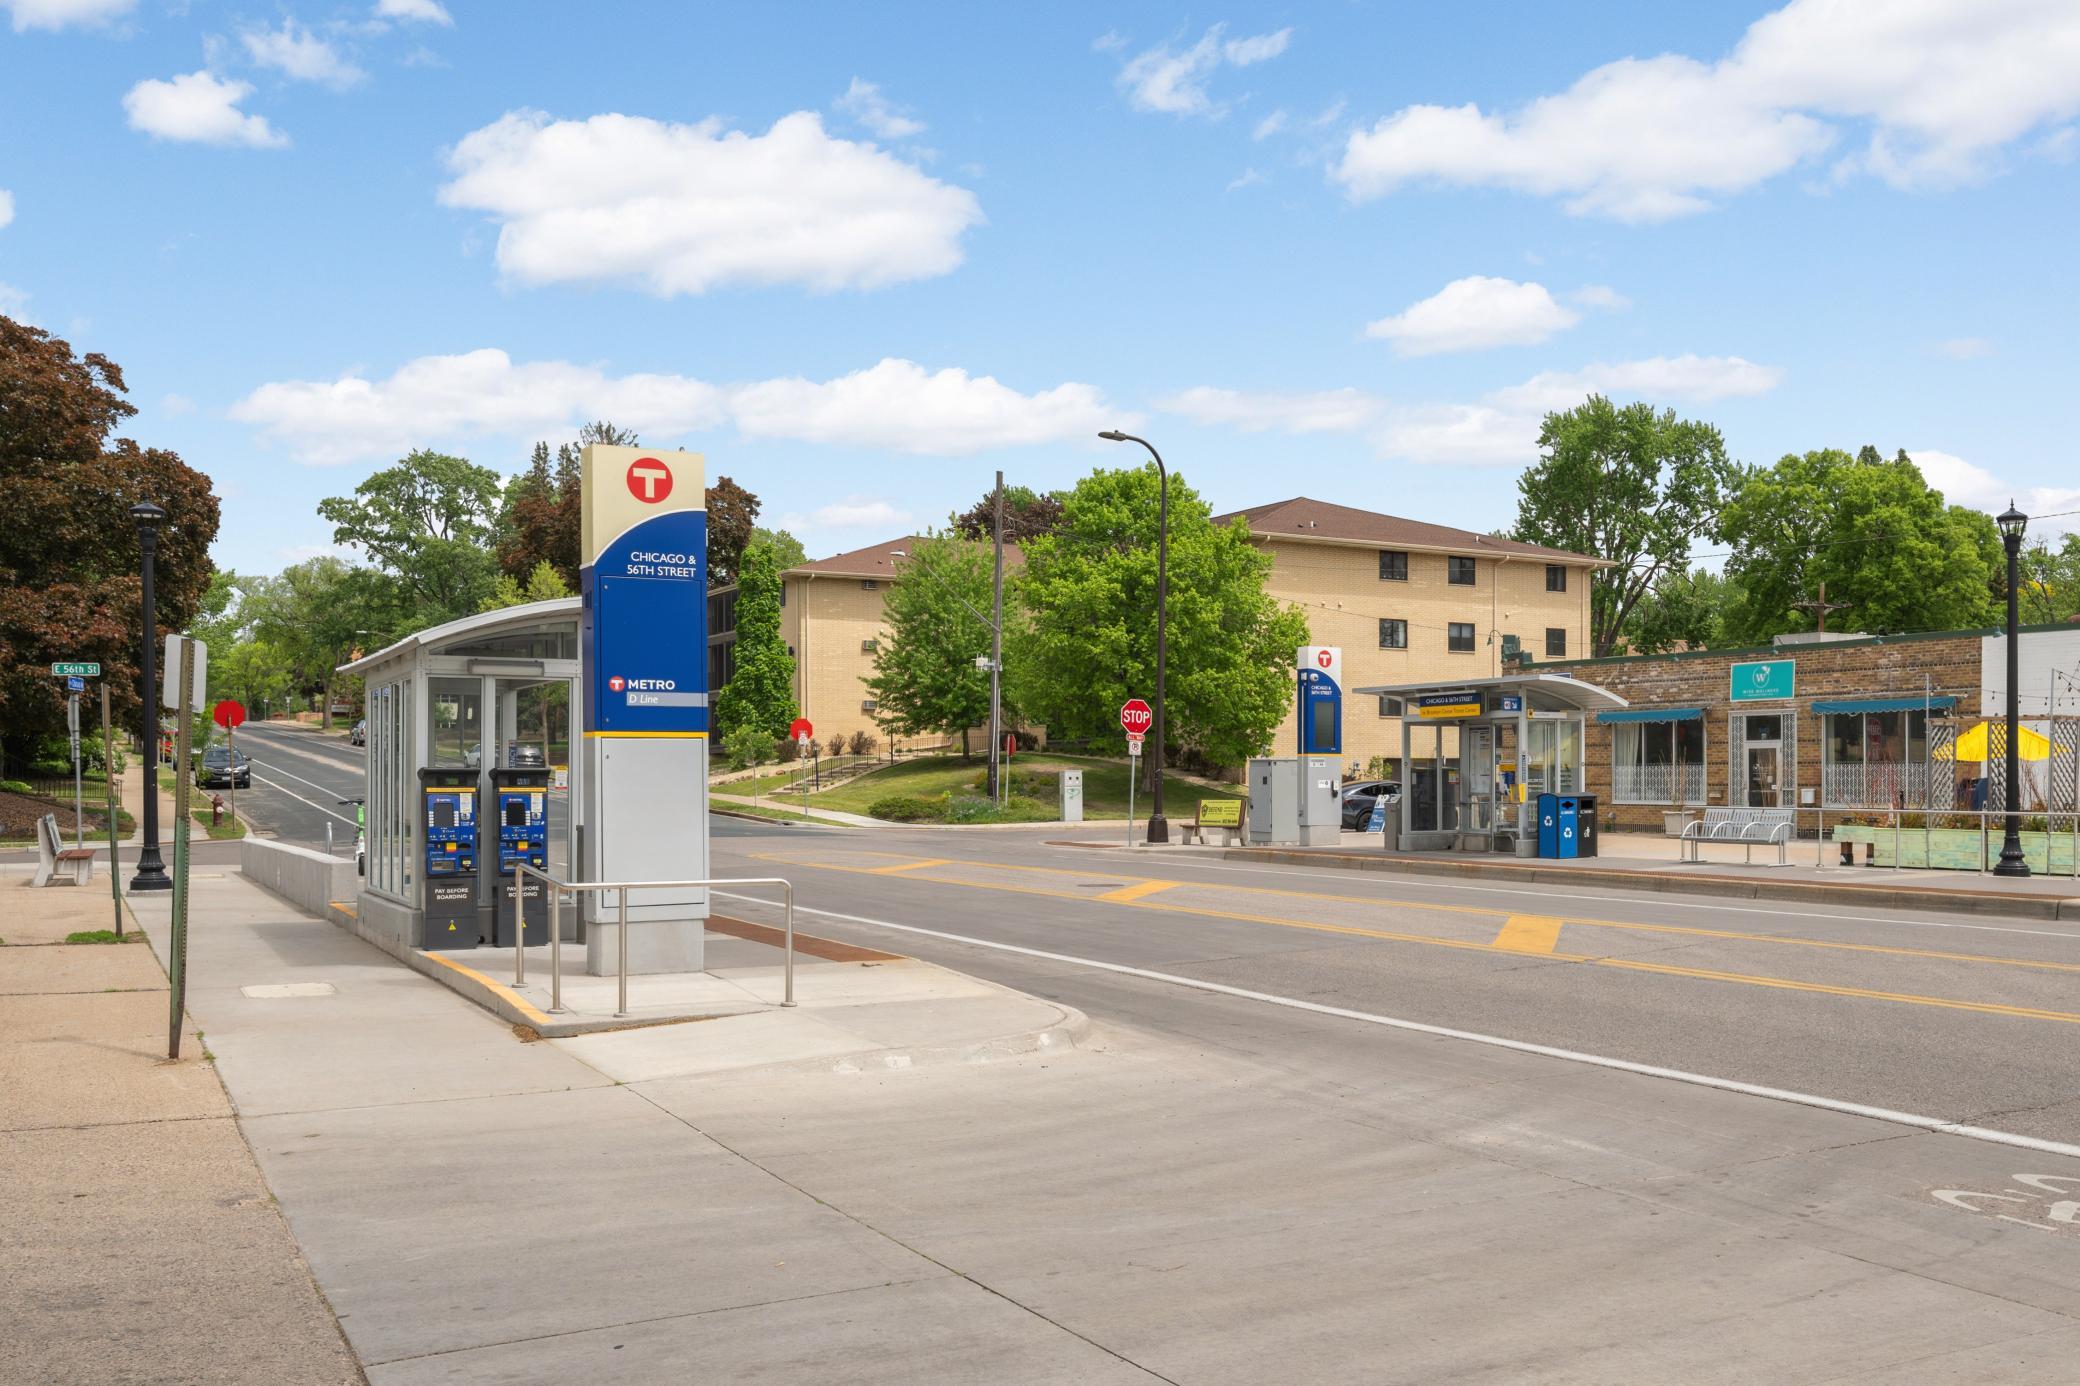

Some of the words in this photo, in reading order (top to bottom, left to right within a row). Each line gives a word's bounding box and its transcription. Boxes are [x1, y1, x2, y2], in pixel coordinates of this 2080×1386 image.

[630, 552, 686, 564] CHICAGO
[688, 556, 696, 564] &
[626, 564, 654, 575] 56TH
[658, 566, 696, 577] STREET
[54, 665, 60, 674] E
[64, 665, 84, 674] 56th
[88, 665, 97, 674] St
[628, 680, 676, 690] METRO
[628, 694, 637, 703] D
[640, 694, 658, 704] Line
[1124, 710, 1150, 724] STOP
